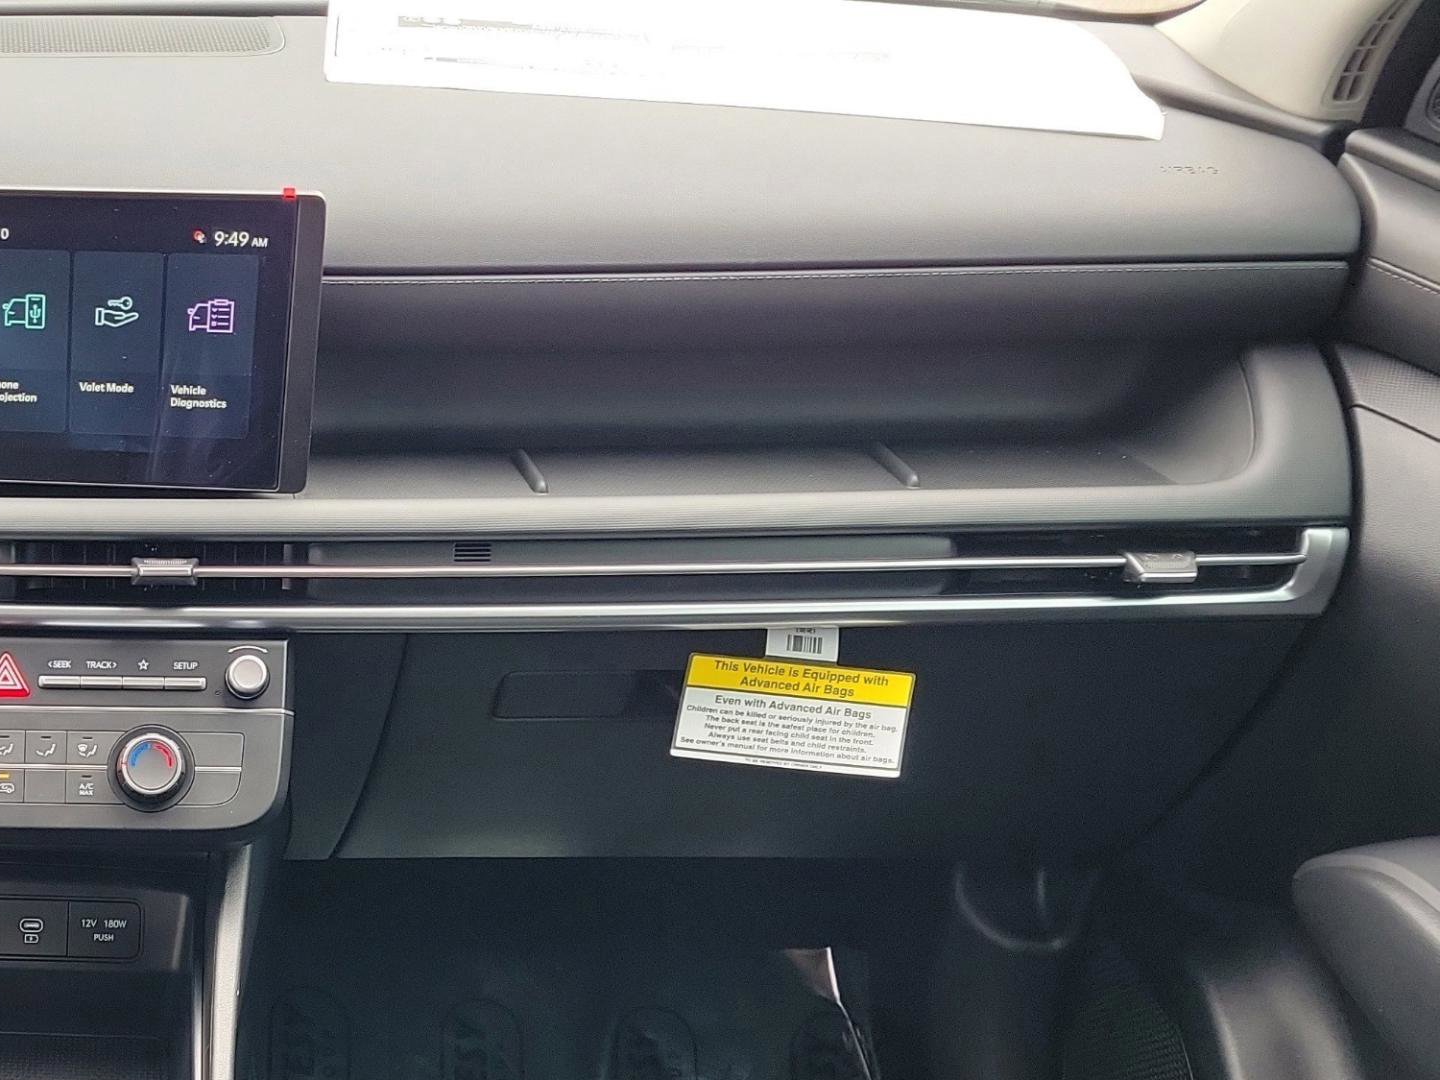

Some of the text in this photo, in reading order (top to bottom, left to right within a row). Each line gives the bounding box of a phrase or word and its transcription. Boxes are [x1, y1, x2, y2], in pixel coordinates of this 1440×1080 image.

[214, 231, 268, 248] 9:49 AM
[79, 382, 134, 393] Valet Mode
[170, 384, 207, 395] Vehicle
[170, 397, 227, 410] Diagnostics
[173, 661, 199, 670] SETUP
[714, 660, 889, 686] This Vehicle is Equipped with
[740, 676, 855, 698] Advanced Air Bags
[715, 695, 872, 720] Even with Advanced Air Bags
[686, 704, 718, 714] Children
[735, 709, 744, 717] be
[746, 710, 766, 719] killed
[778, 714, 814, 724] seriously
[815, 716, 841, 726] injured
[843, 719, 853, 729] by
[855, 721, 868, 729] the
[869, 722, 880, 730] air
[705, 714, 720, 722] The
[721, 716, 739, 724] back
[781, 721, 805, 730] safest
[806, 724, 827, 734] place
[829, 726, 840, 734] for
[704, 723, 726, 731] Never
[727, 725, 741, 733] put
[765, 729, 789, 738] facing
[680, 736, 694, 744] See
[727, 742, 755, 750] manual
[791, 748, 835, 759] information
[836, 753, 860, 761] about
[708, 731, 735, 741] Always
[752, 736, 769, 744] seat
[770, 738, 789, 746] belts
[807, 742, 826, 750] child
[79, 782, 95, 790] A/C
[80, 918, 127, 929] 12V 180W
[93, 934, 115, 943] PUSH
